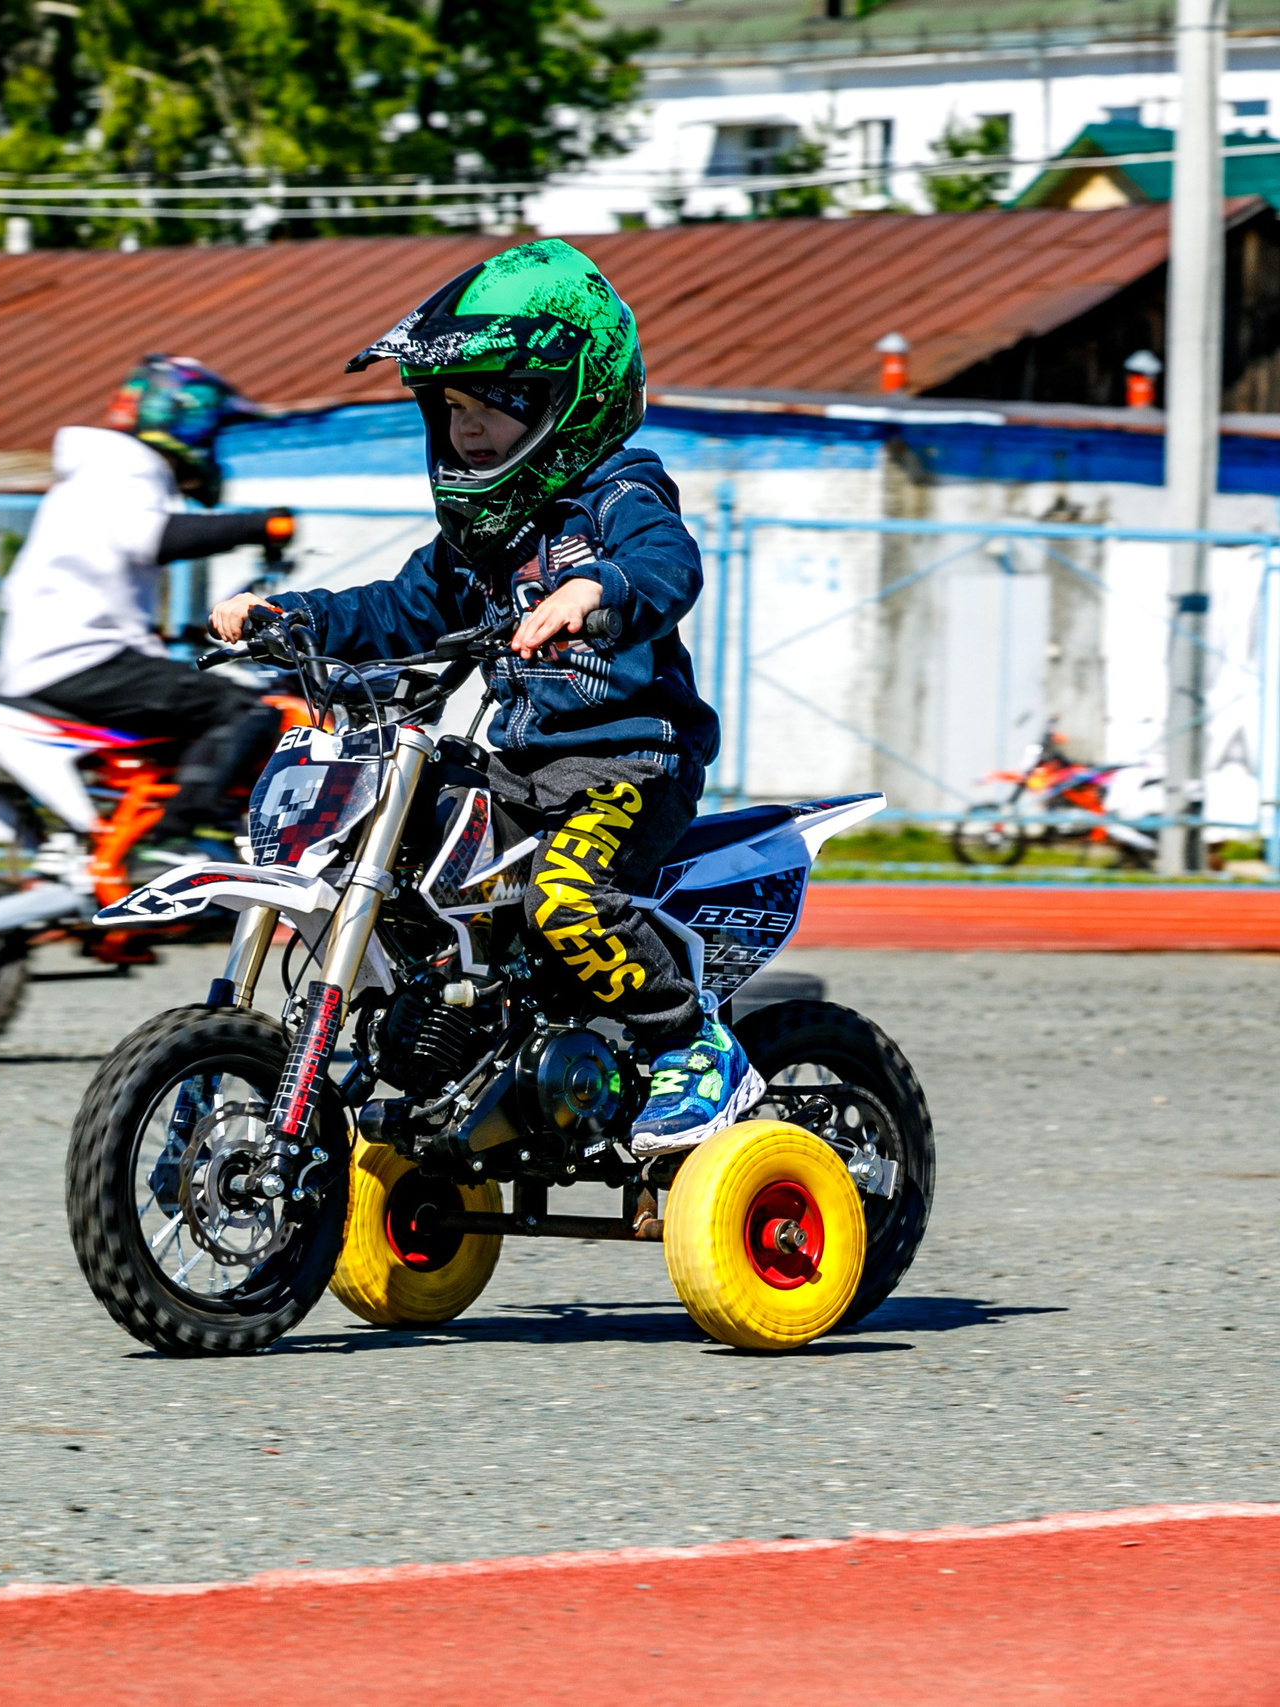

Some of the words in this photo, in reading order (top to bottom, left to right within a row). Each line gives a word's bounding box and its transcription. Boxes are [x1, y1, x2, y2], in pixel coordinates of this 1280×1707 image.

[534, 781, 646, 1003] SNEAKERS
[685, 904, 794, 933] BSE
[583, 1140, 606, 1158] BSE
